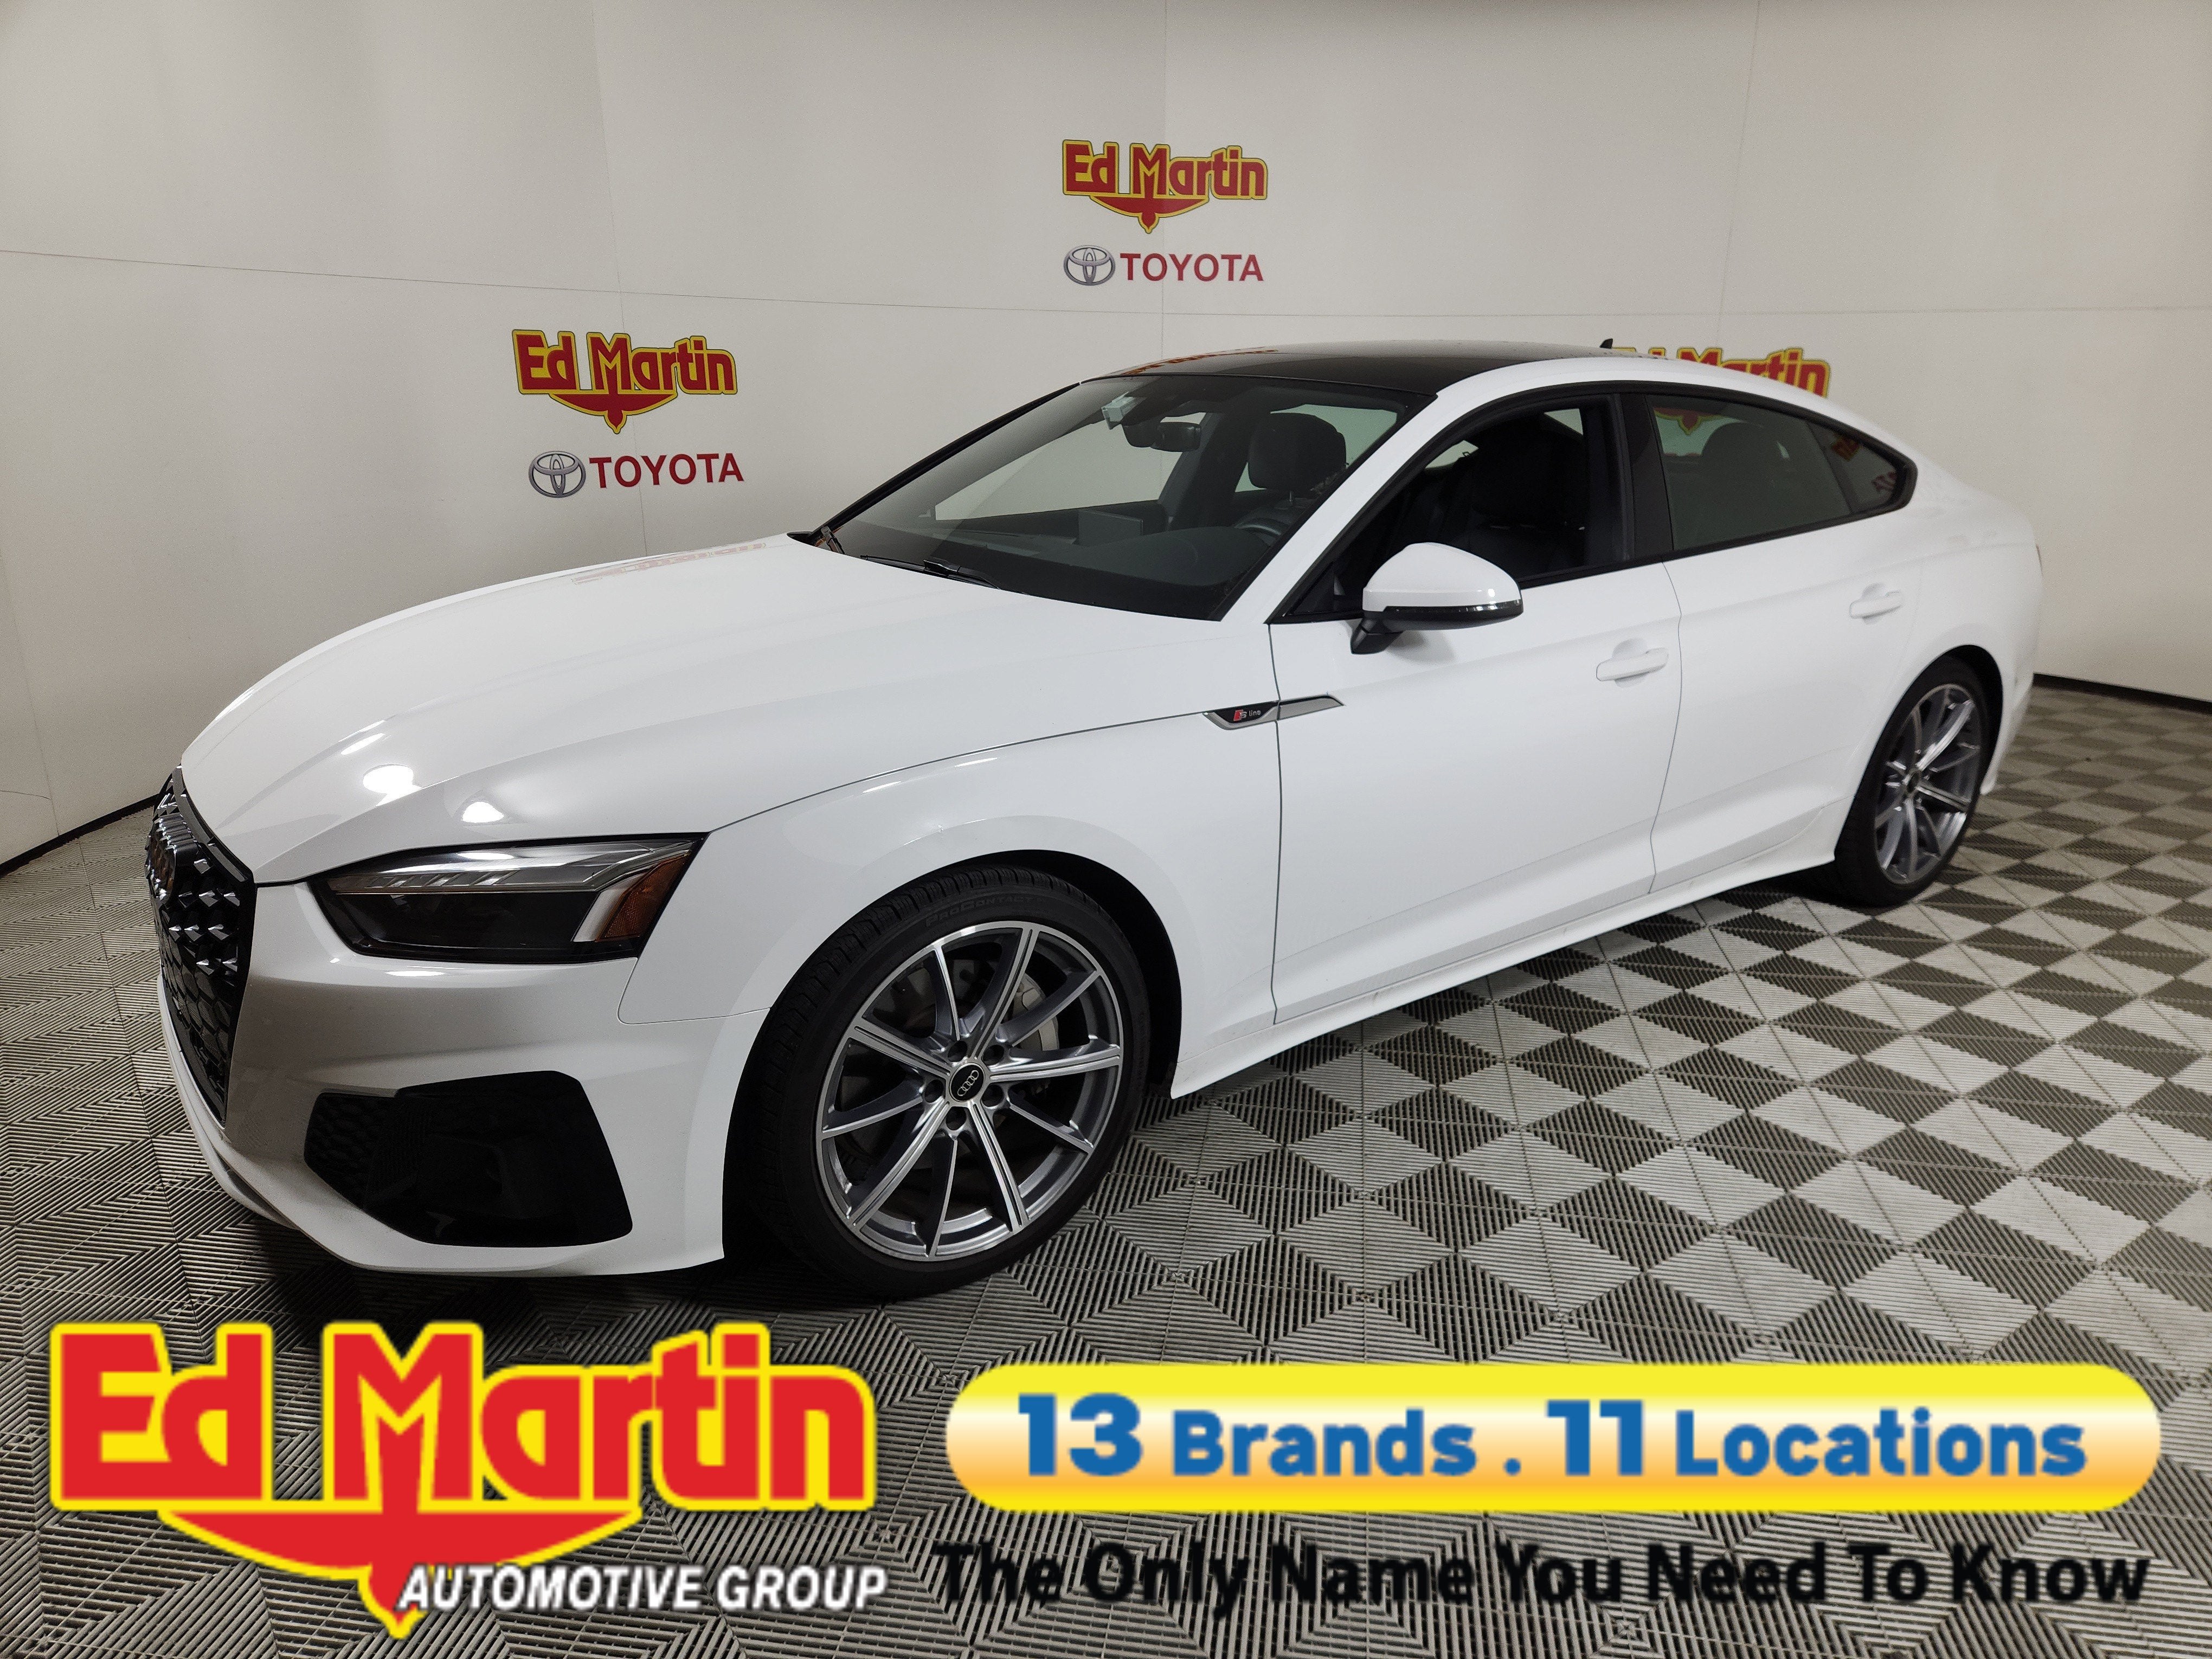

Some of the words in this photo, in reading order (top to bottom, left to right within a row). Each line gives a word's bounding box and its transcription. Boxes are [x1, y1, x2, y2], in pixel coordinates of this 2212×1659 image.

[1064, 140, 1118, 194] Ed
[1131, 144, 1266, 198] Martin
[1120, 253, 1263, 281] TOYOTA
[513, 331, 578, 393] Ed
[588, 333, 736, 393] Martin
[589, 453, 744, 488] TOYOTA
